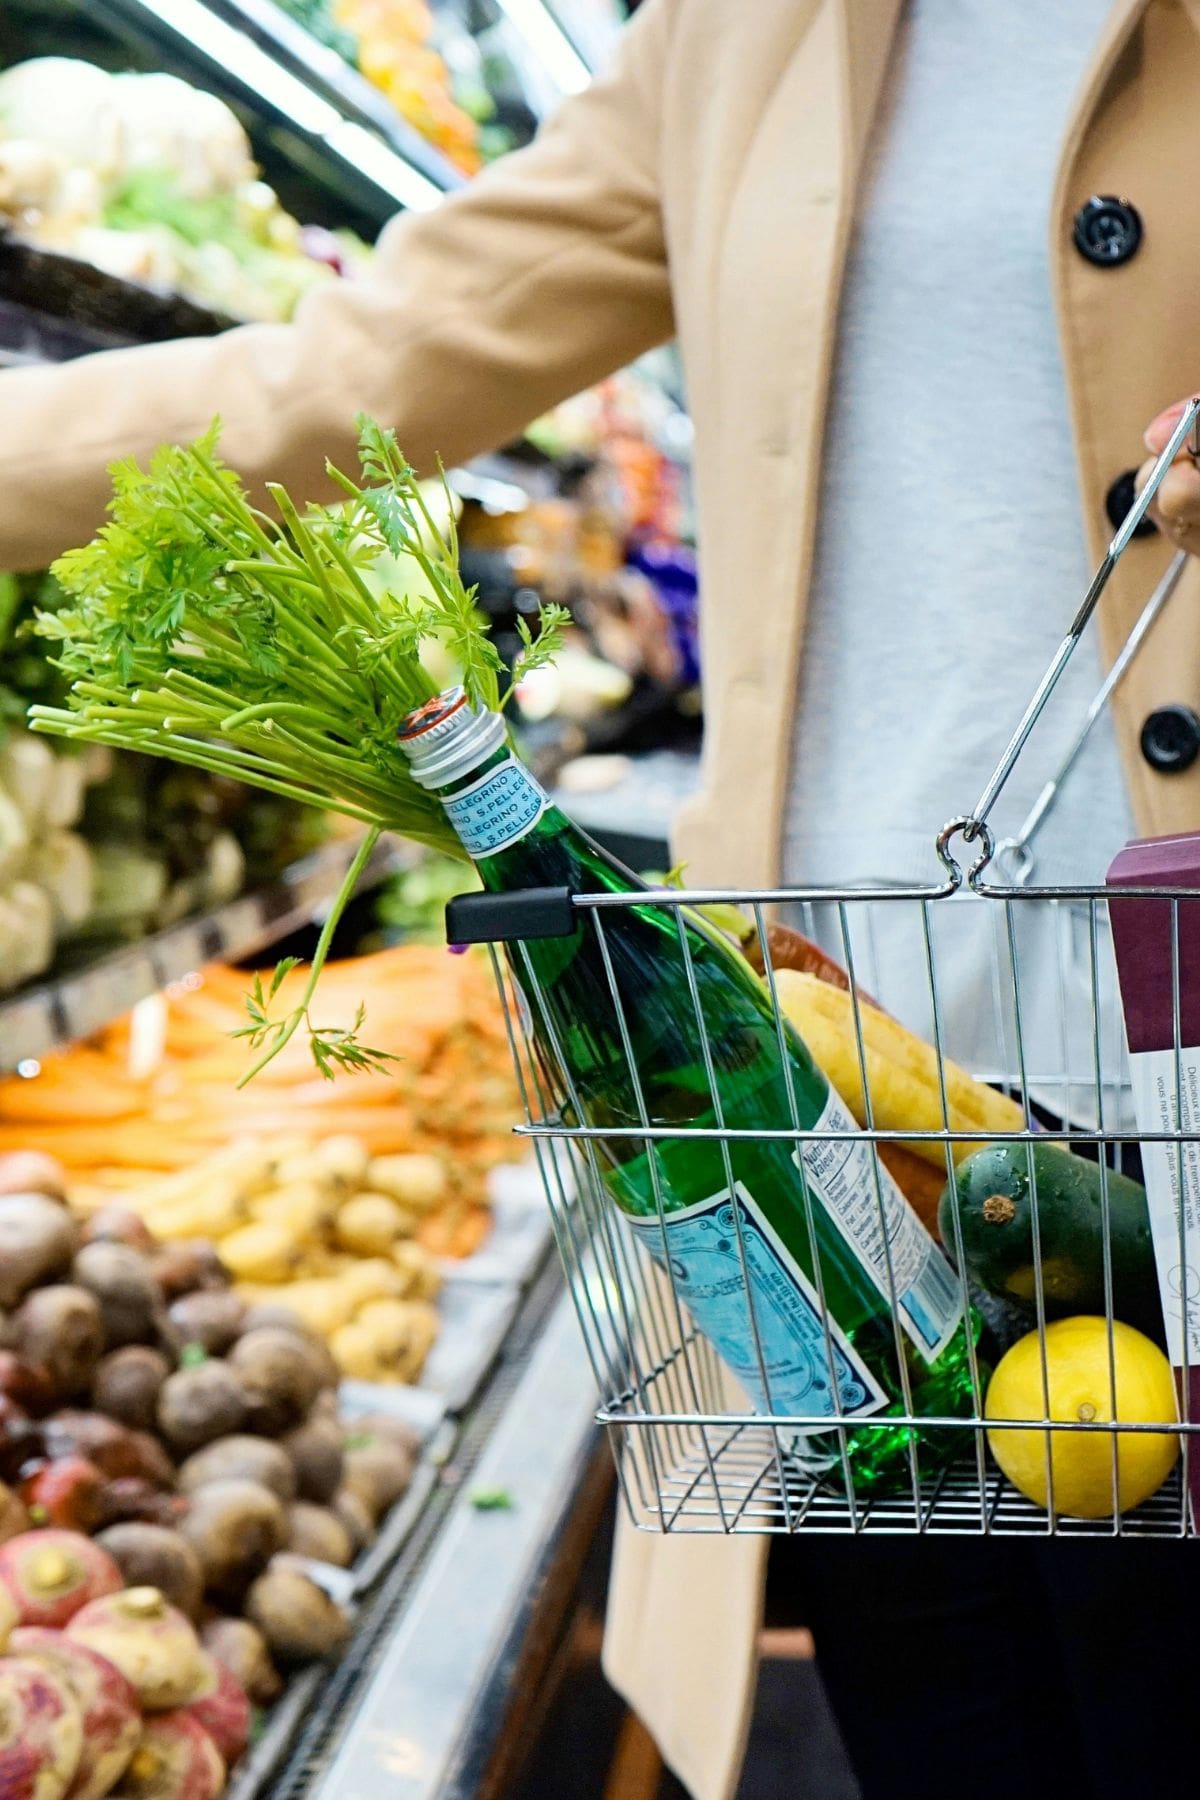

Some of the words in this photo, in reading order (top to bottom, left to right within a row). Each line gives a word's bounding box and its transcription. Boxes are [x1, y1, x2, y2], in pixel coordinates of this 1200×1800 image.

[1157, 1076, 1166, 1098] vous
[1188, 1067, 1199, 1108] Délicieux
[1160, 1101, 1168, 1112] ne
[810, 1149, 836, 1178] Valeur
[1166, 1152, 1177, 1171] plus
[1188, 1151, 1196, 1162] de
